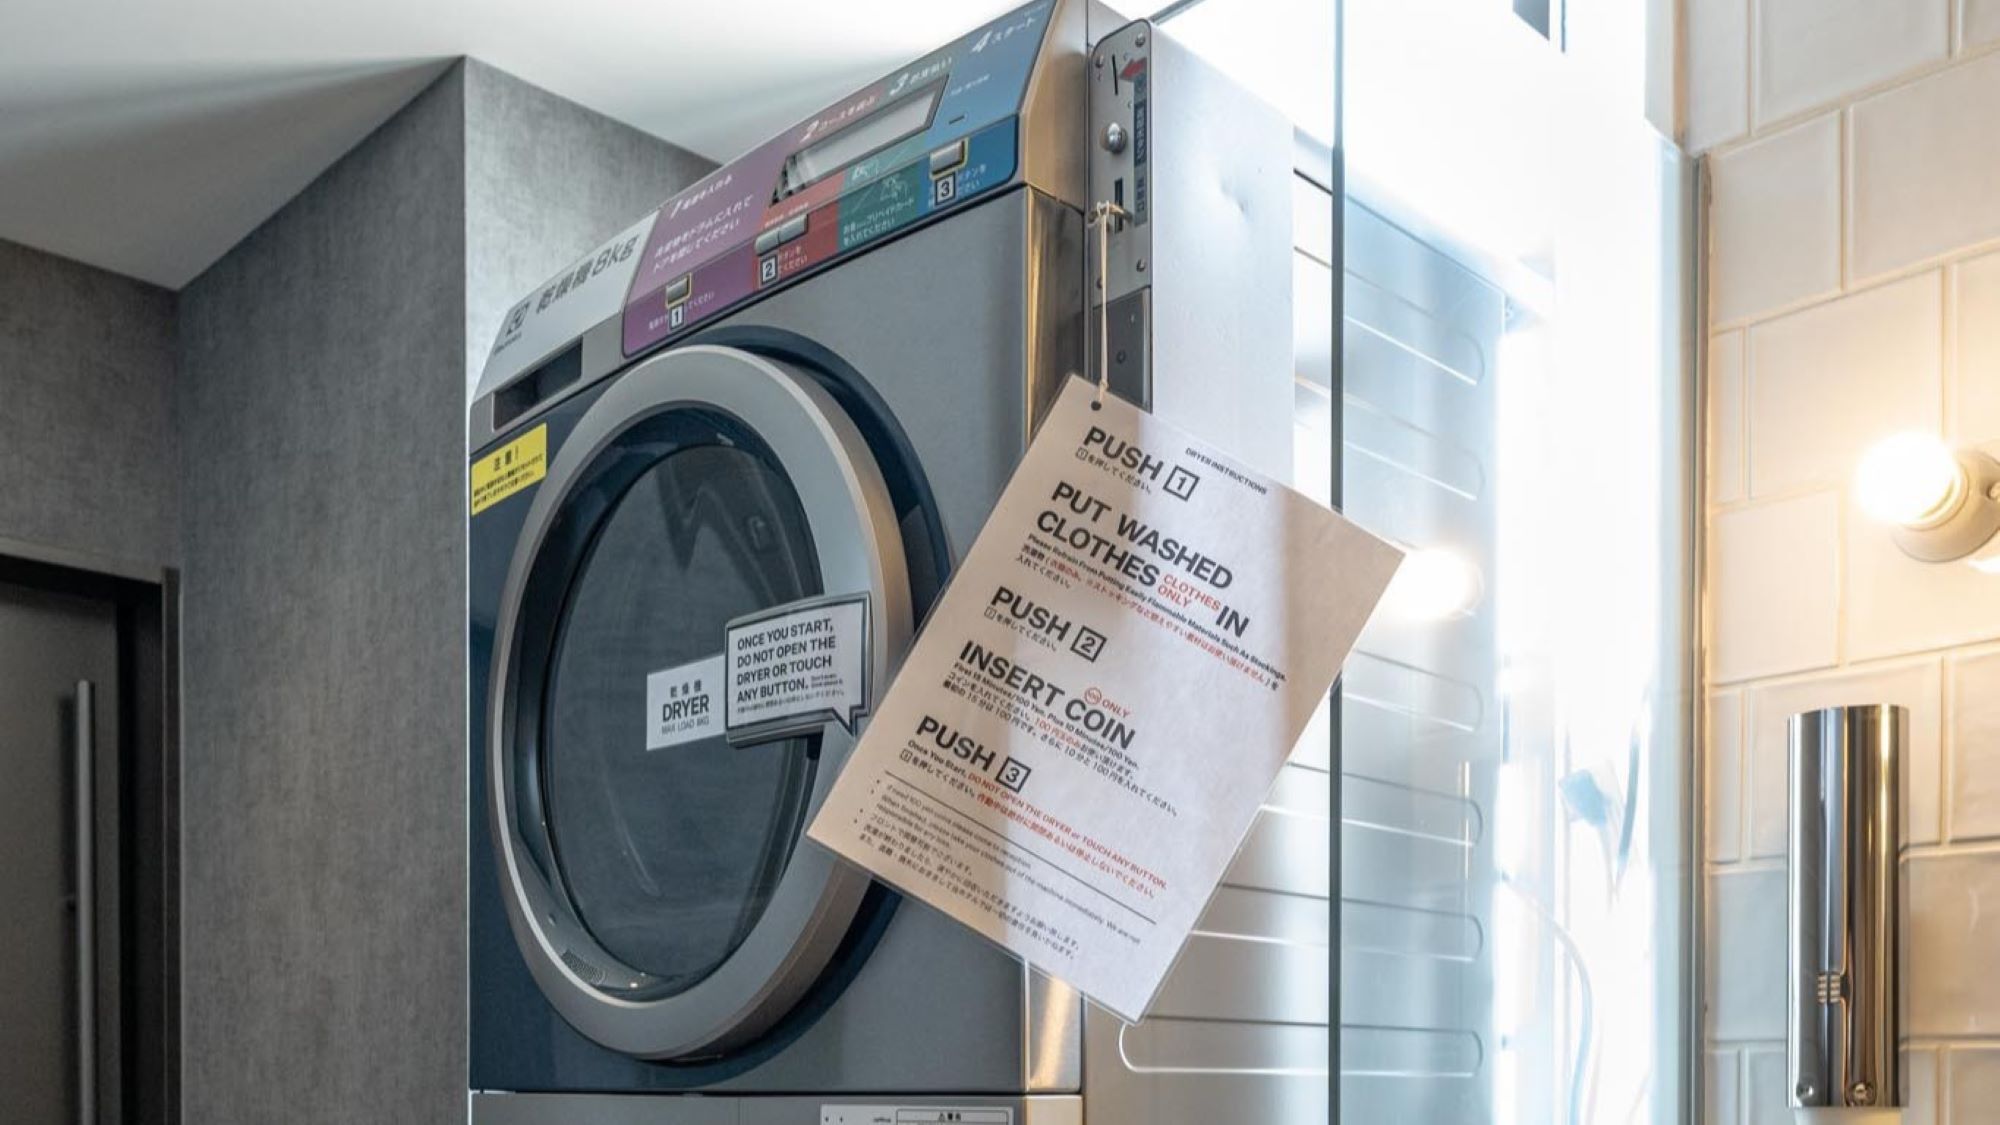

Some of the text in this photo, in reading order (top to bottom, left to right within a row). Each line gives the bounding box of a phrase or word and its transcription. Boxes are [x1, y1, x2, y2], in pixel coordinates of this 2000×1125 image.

[1084, 427, 1164, 480] PUSH
[1185, 447, 1267, 495] DRYER INSTRUCTIONS
[1051, 481, 1232, 589] PUT WASHED
[1037, 511, 1249, 638] CLOTHES IN
[1163, 574, 1221, 611] CLOTHES
[991, 586, 1071, 641] PUSH
[1078, 560, 1101, 576] From
[1098, 570, 1126, 591] Putting
[1147, 596, 1187, 623] Flammable
[1187, 618, 1221, 643] Materials
[1221, 638, 1240, 654] Such
[1239, 649, 1250, 660] As
[1157, 584, 1192, 608] ONLY
[737, 618, 833, 651] ONCE YOU START,
[737, 635, 836, 669] DO NOT OPEN THE
[737, 655, 832, 686] DRYER OR TOUCH
[662, 694, 710, 722] DRYER
[737, 687, 758, 703] ANY
[759, 677, 809, 698] BUTTON.
[960, 641, 1135, 750] INSERT COIN
[1101, 699, 1130, 718] ONLY
[677, 718, 695, 732] LOAD
[1047, 712, 1064, 727] Plus
[916, 716, 996, 771] PUSH
[907, 739, 929, 756] Once
[930, 750, 945, 765] You
[945, 759, 967, 778] Start,
[967, 772, 982, 784] DO
[981, 779, 1001, 794] NOT
[999, 790, 1025, 808] OPEN
[1025, 803, 1041, 818] THE
[1042, 814, 1072, 835] DRYER
[1082, 836, 1112, 858] TOUCH
[1111, 853, 1131, 868] ANY
[1129, 863, 1167, 889] BUTTON.
